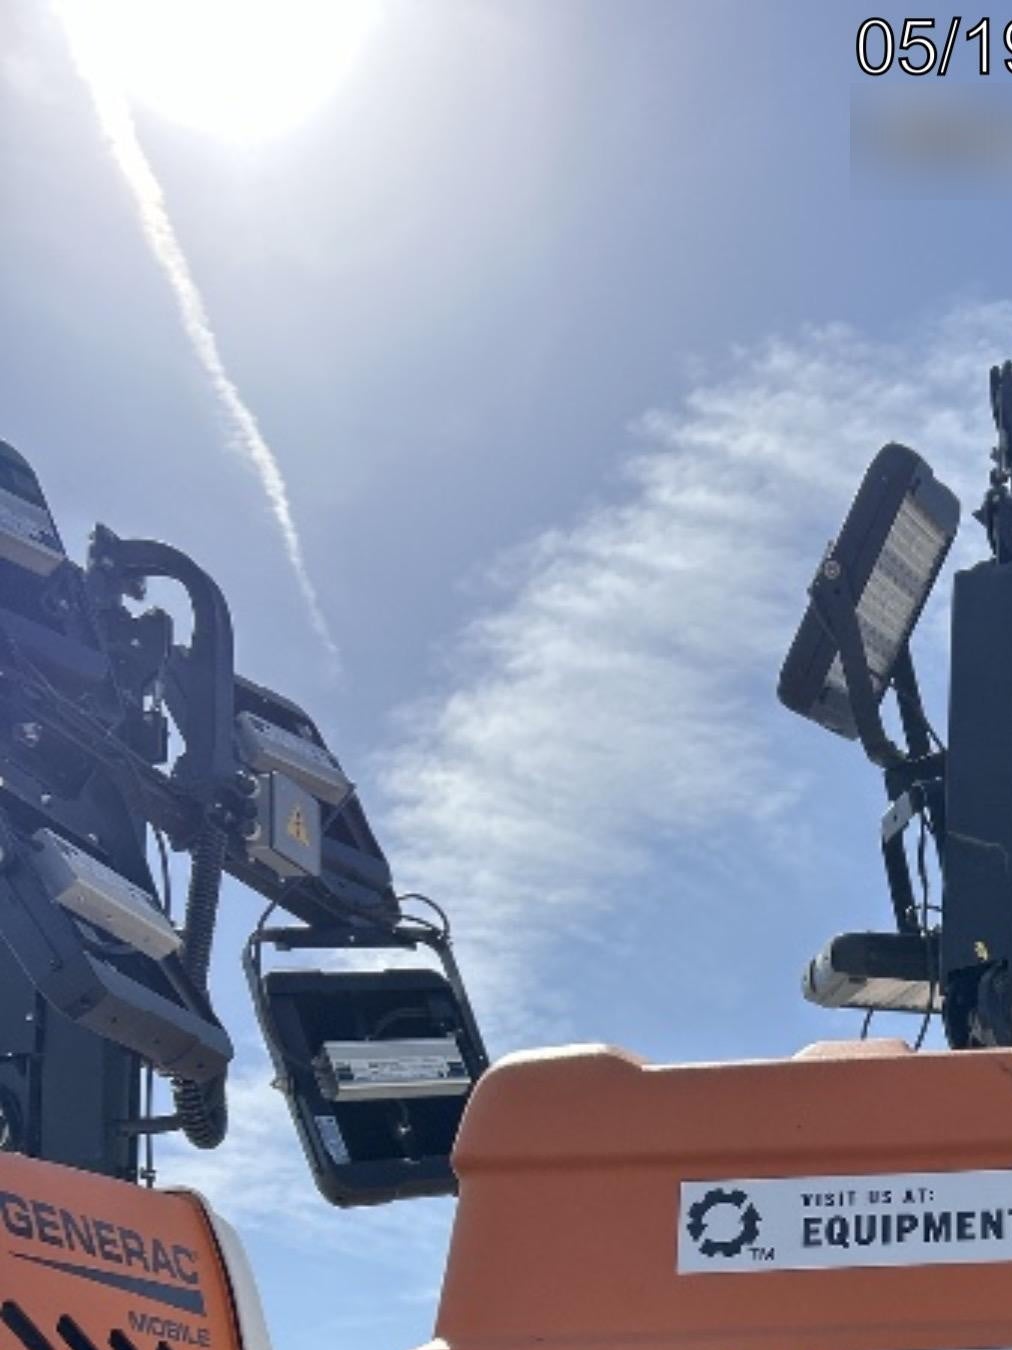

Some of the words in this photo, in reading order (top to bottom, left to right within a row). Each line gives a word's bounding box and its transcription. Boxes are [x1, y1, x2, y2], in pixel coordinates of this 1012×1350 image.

[801, 1190, 856, 1208] VISIT
[869, 1189, 893, 1204] US
[902, 1187, 935, 1204] AT:
[0, 1190, 199, 1285] GENERAC
[127, 1310, 211, 1348] MOBILE
